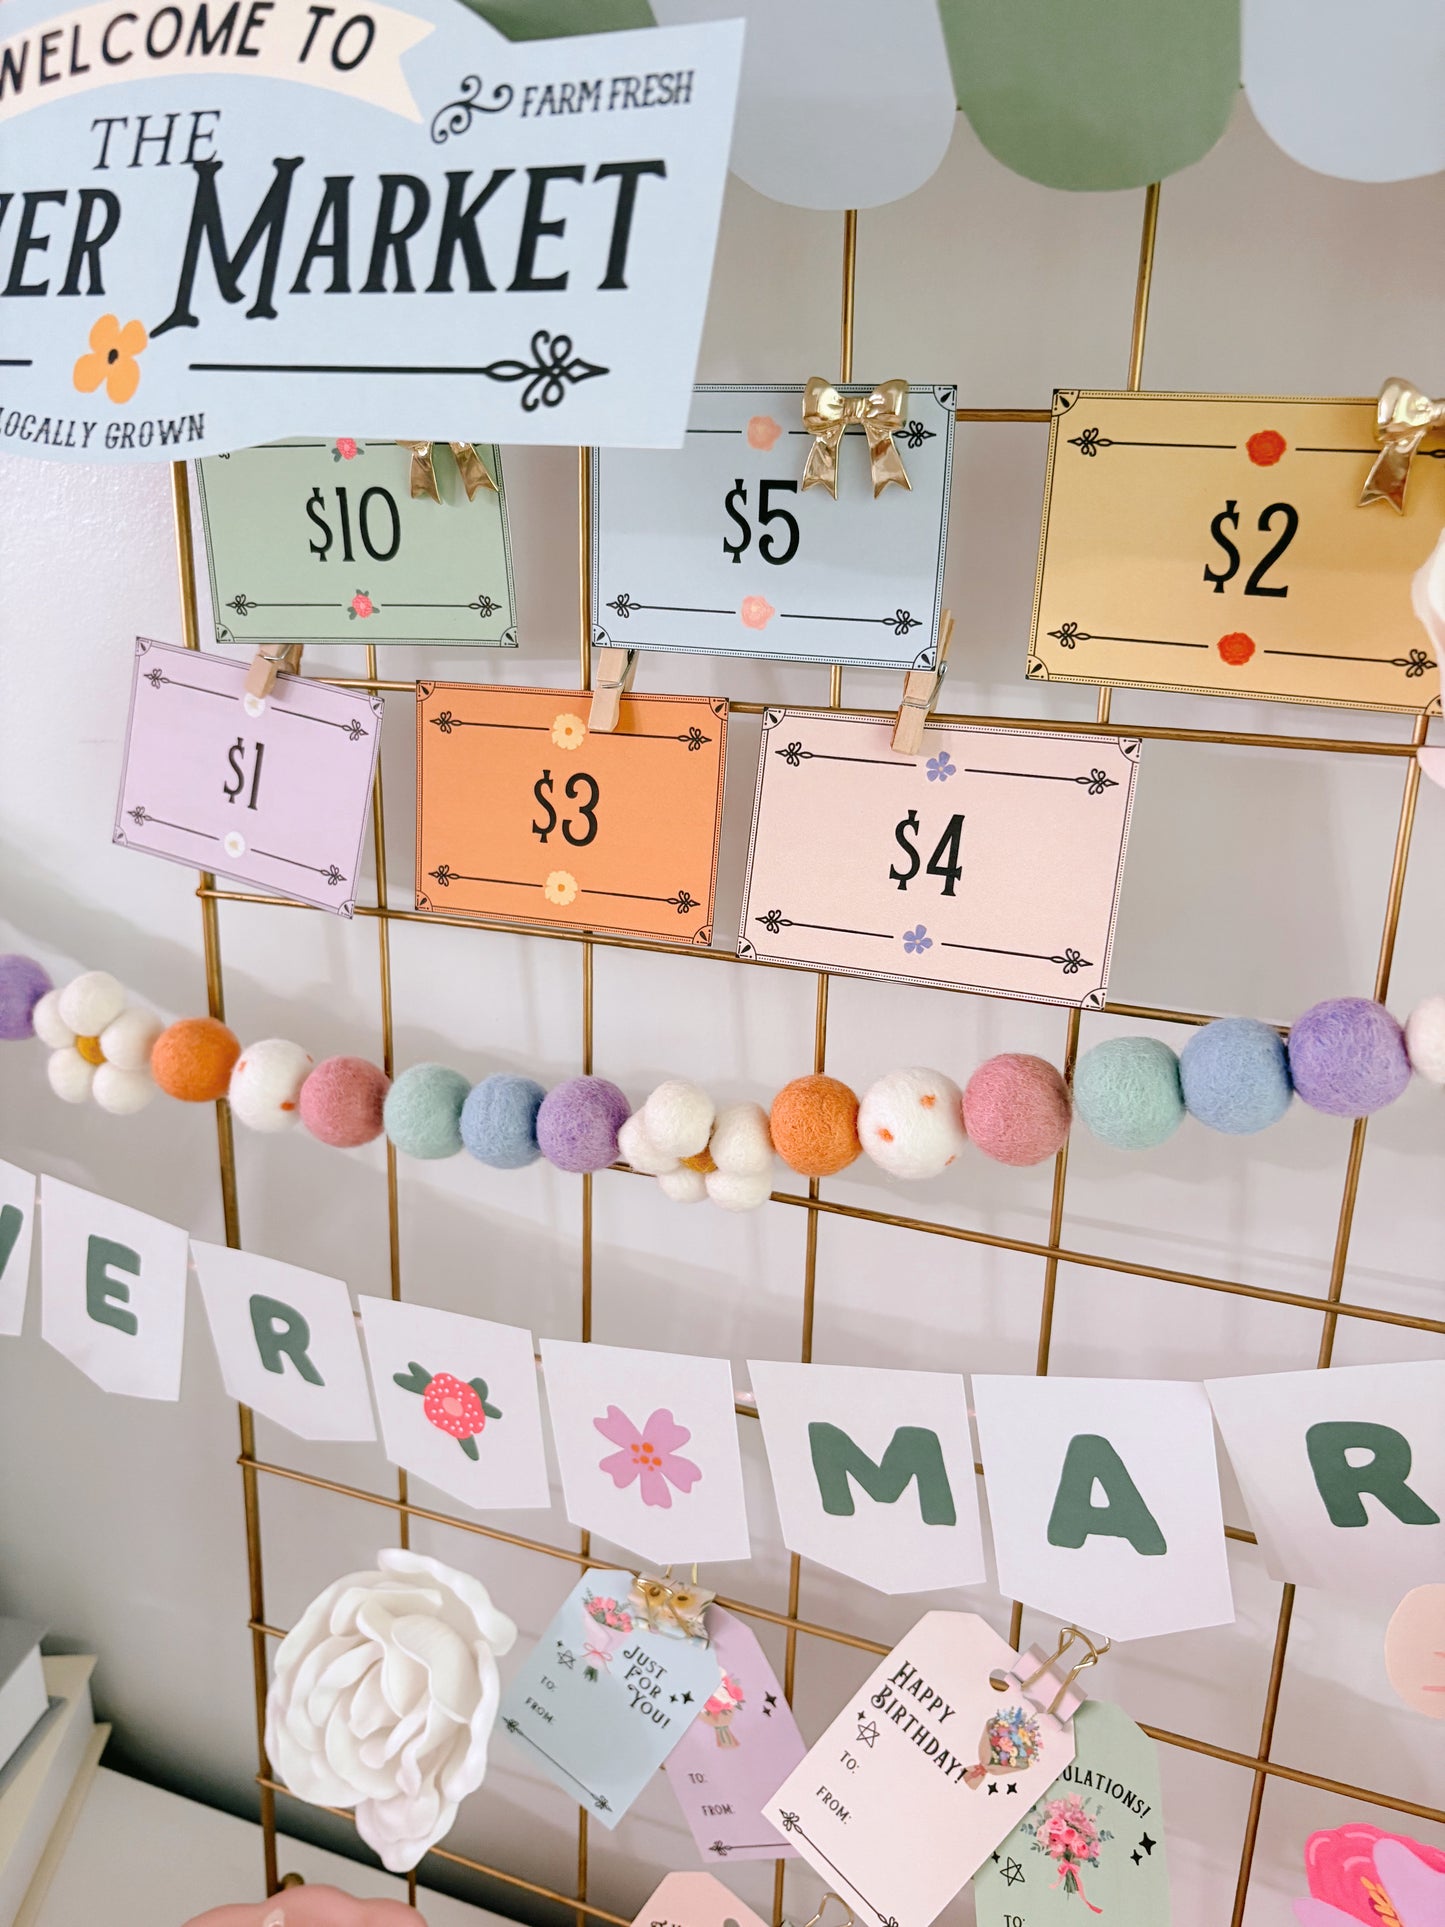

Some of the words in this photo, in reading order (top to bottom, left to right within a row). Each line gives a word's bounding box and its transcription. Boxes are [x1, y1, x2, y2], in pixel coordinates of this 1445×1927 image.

[299, 6, 375, 71] TO
[521, 80, 602, 117] FARM
[608, 71, 694, 110] FRESH
[92, 110, 220, 169] THE
[0, 189, 121, 297] ER
[149, 156, 666, 338] MARKET
[105, 413, 204, 449] GROWN
[306, 487, 400, 561] $10
[724, 479, 799, 565] $5
[1204, 500, 1299, 597] $2
[224, 737, 264, 810] $1
[532, 770, 599, 846] $3
[889, 810, 965, 896] $4
[623, 1646, 668, 1679] JUST
[624, 1665, 661, 1698] FOR
[888, 1661, 955, 1723] HAPPY
[627, 1682, 671, 1729] YOU!
[871, 1685, 968, 1783] BIRTHDAY!
[841, 1751, 859, 1773] TO:
[1055, 1765, 1152, 1819] ULATIONS!
[816, 1786, 851, 1824] FROM:
